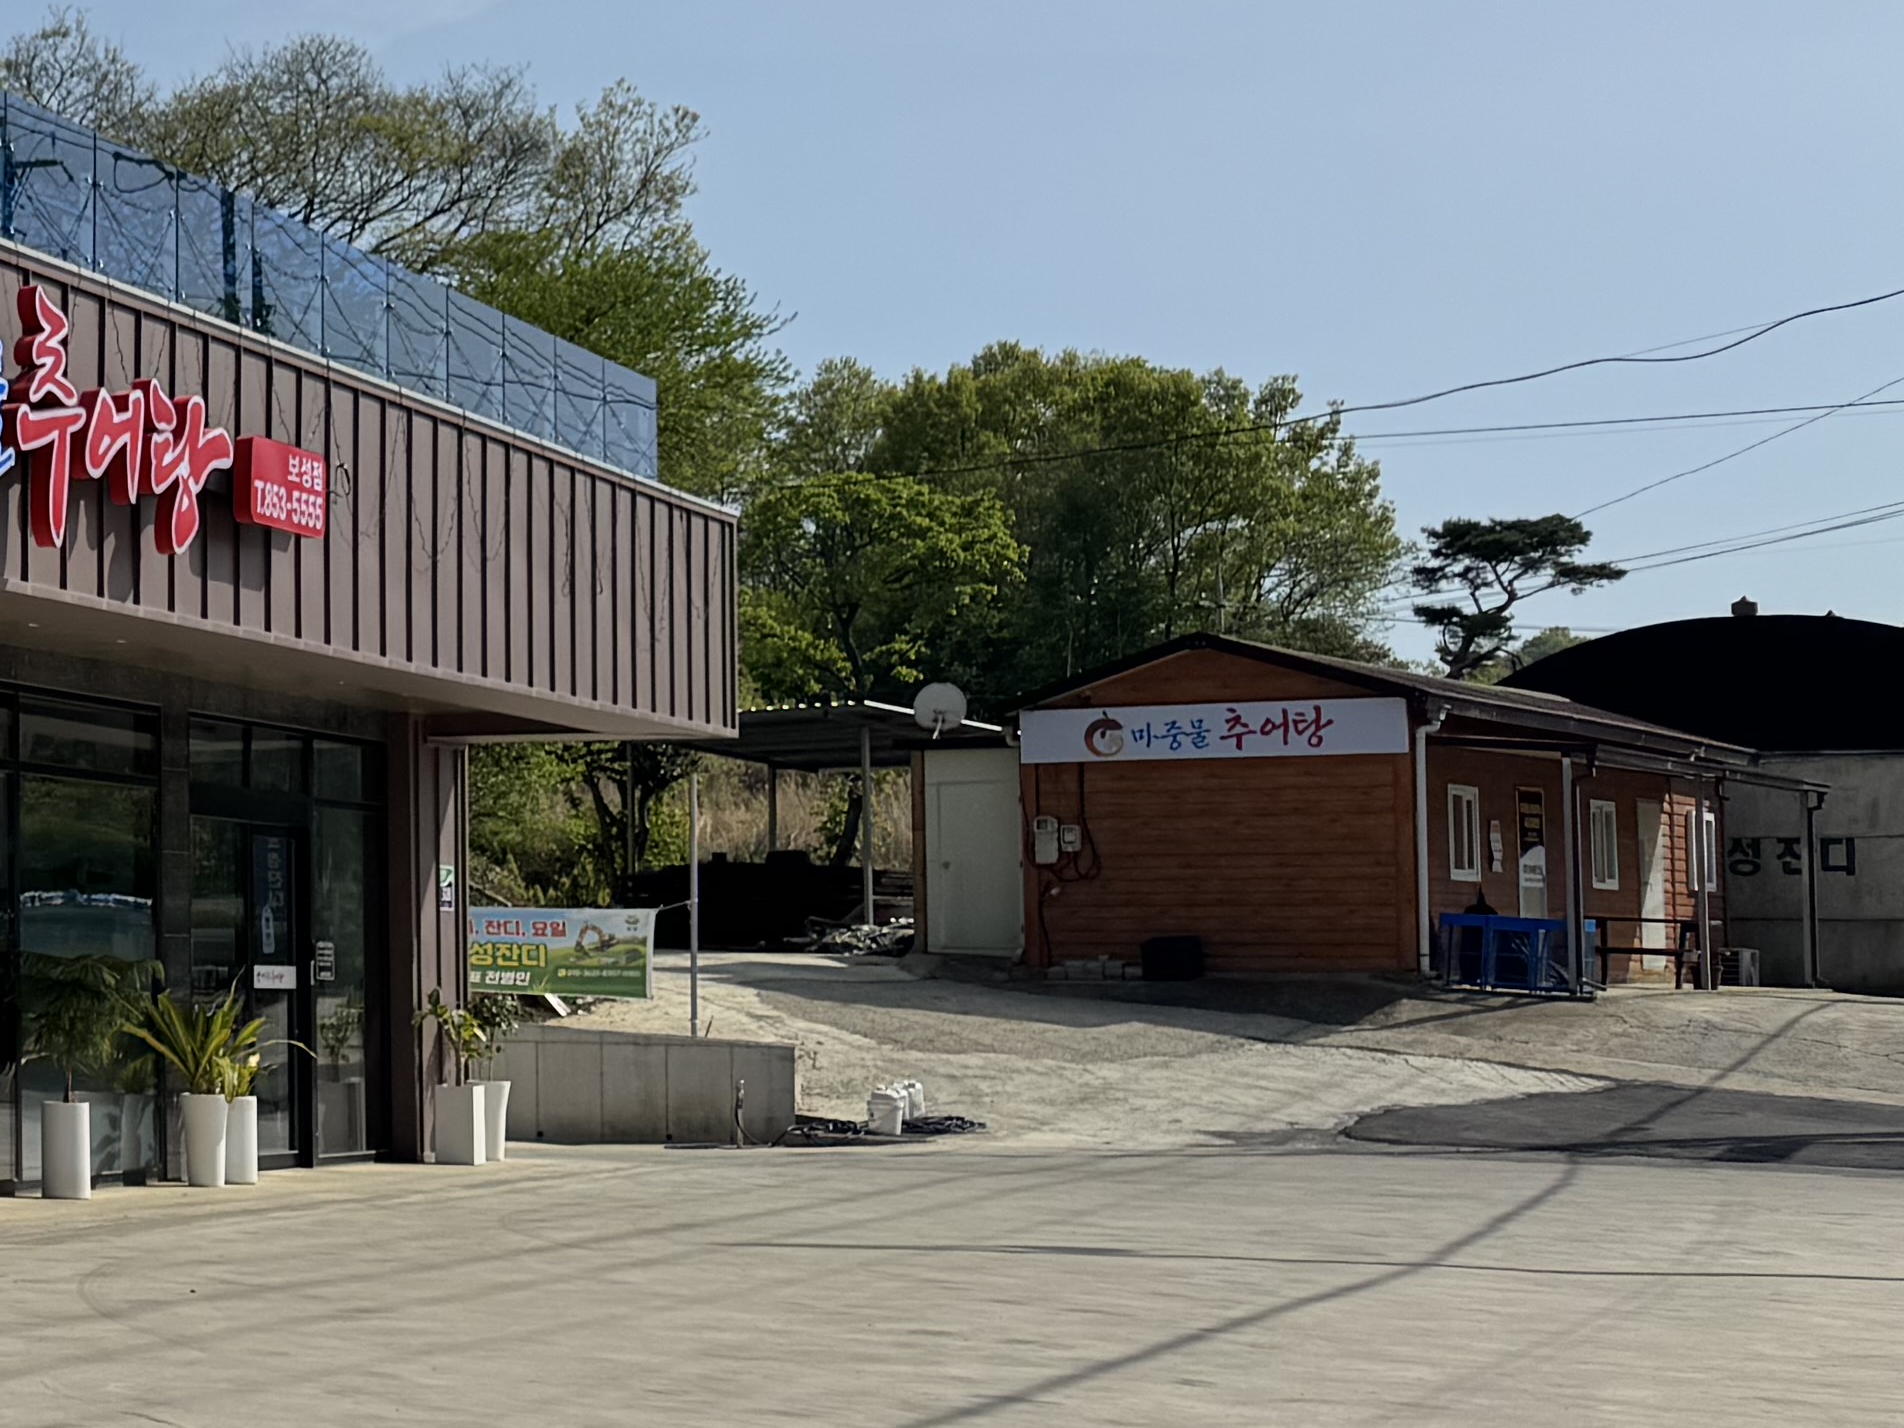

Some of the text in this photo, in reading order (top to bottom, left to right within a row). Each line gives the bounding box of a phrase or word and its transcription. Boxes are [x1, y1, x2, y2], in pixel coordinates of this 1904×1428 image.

[14, 284, 234, 556] 추어탕
[287, 454, 323, 492] 보성점
[1219, 705, 1334, 751] 추어탕
